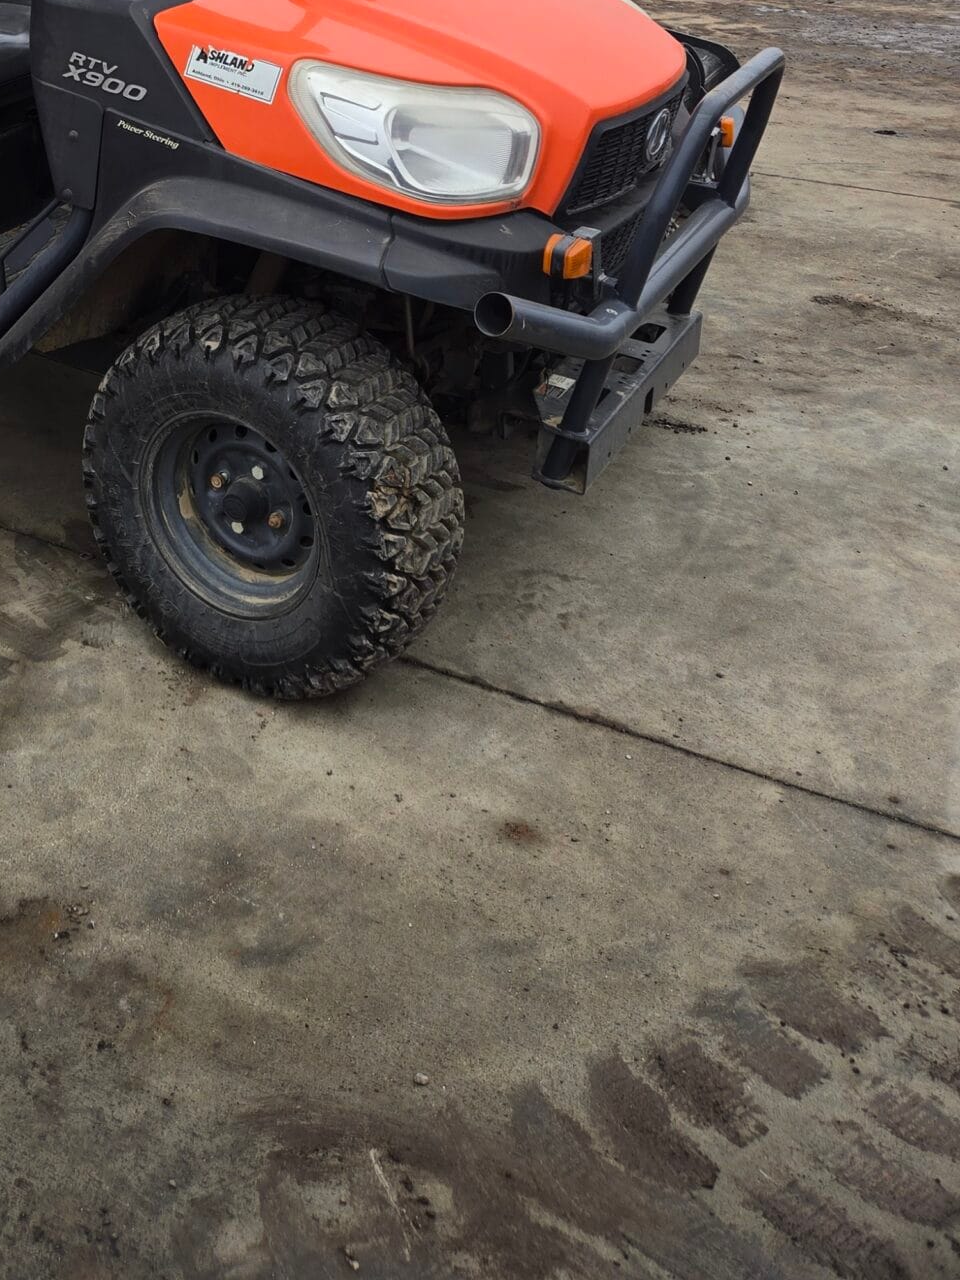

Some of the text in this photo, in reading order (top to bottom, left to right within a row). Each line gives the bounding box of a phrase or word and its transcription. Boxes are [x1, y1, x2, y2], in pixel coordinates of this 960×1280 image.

[69, 51, 118, 74] RTV
[196, 47, 254, 72] ASHLAND
[62, 64, 147, 101] X900
[117, 120, 179, 150] Power Steering
